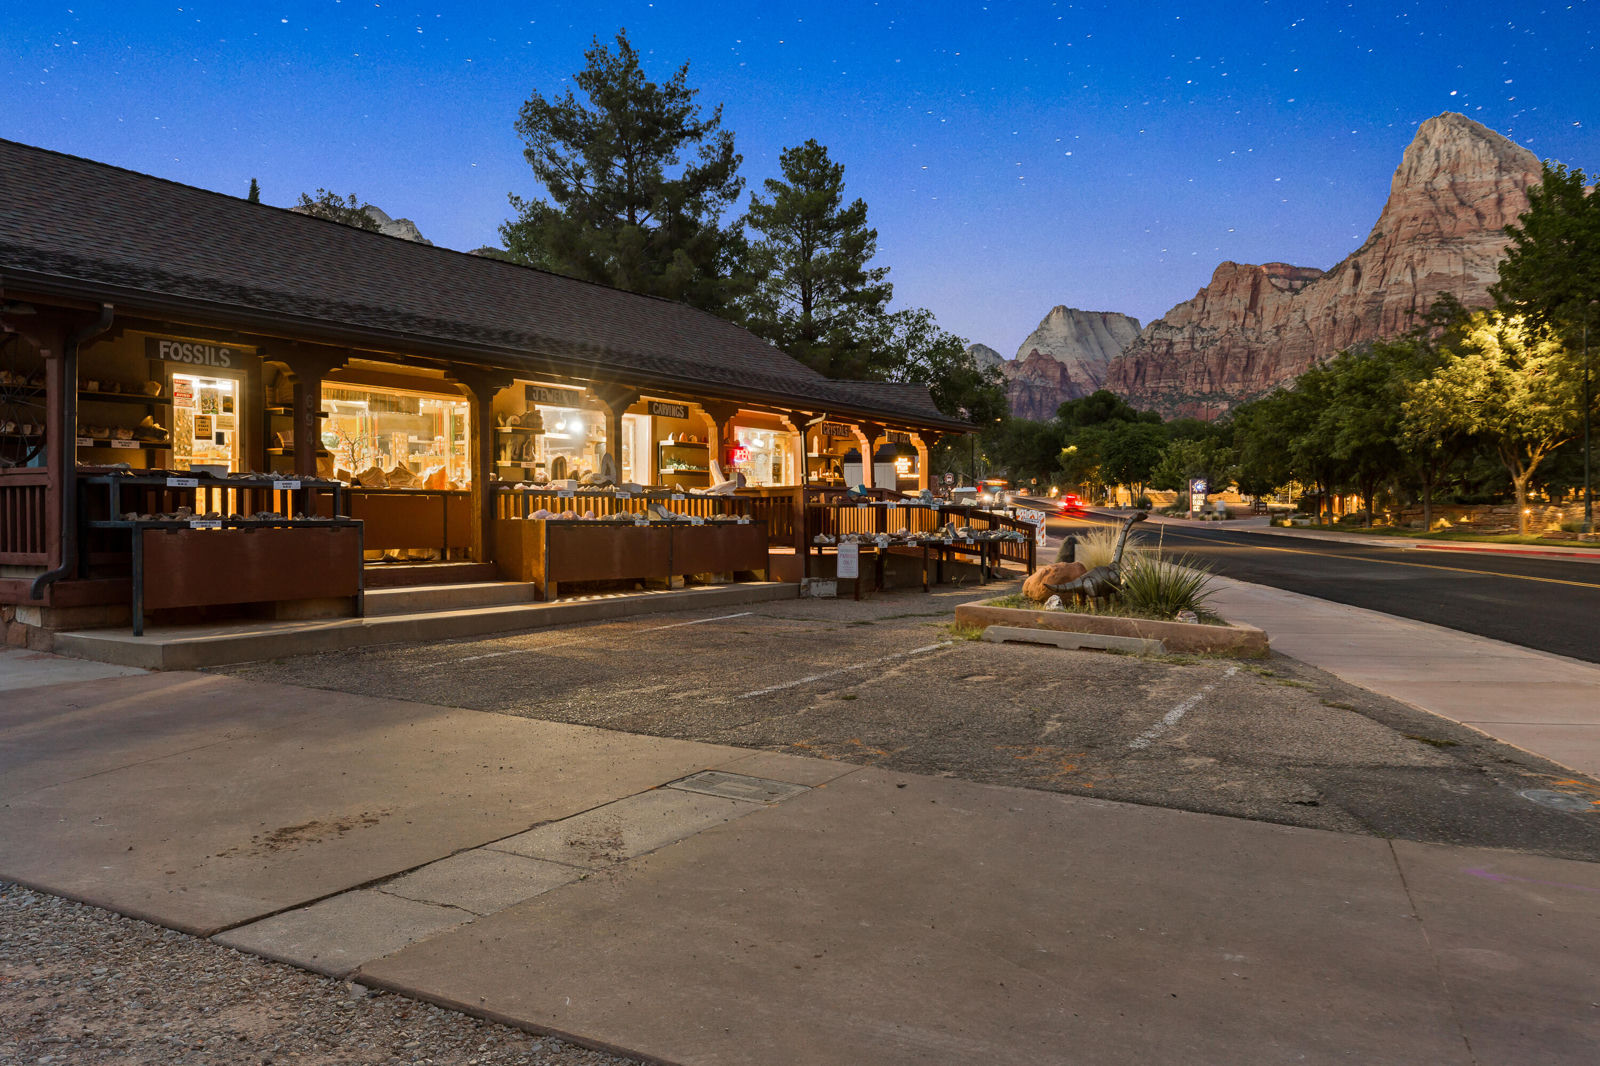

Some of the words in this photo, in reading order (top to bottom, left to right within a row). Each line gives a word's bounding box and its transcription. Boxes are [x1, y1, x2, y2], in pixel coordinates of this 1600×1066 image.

[159, 340, 231, 367] FOSSILS
[653, 402, 685, 418] CARVINGS
[823, 424, 849, 438] CRYSTALS
